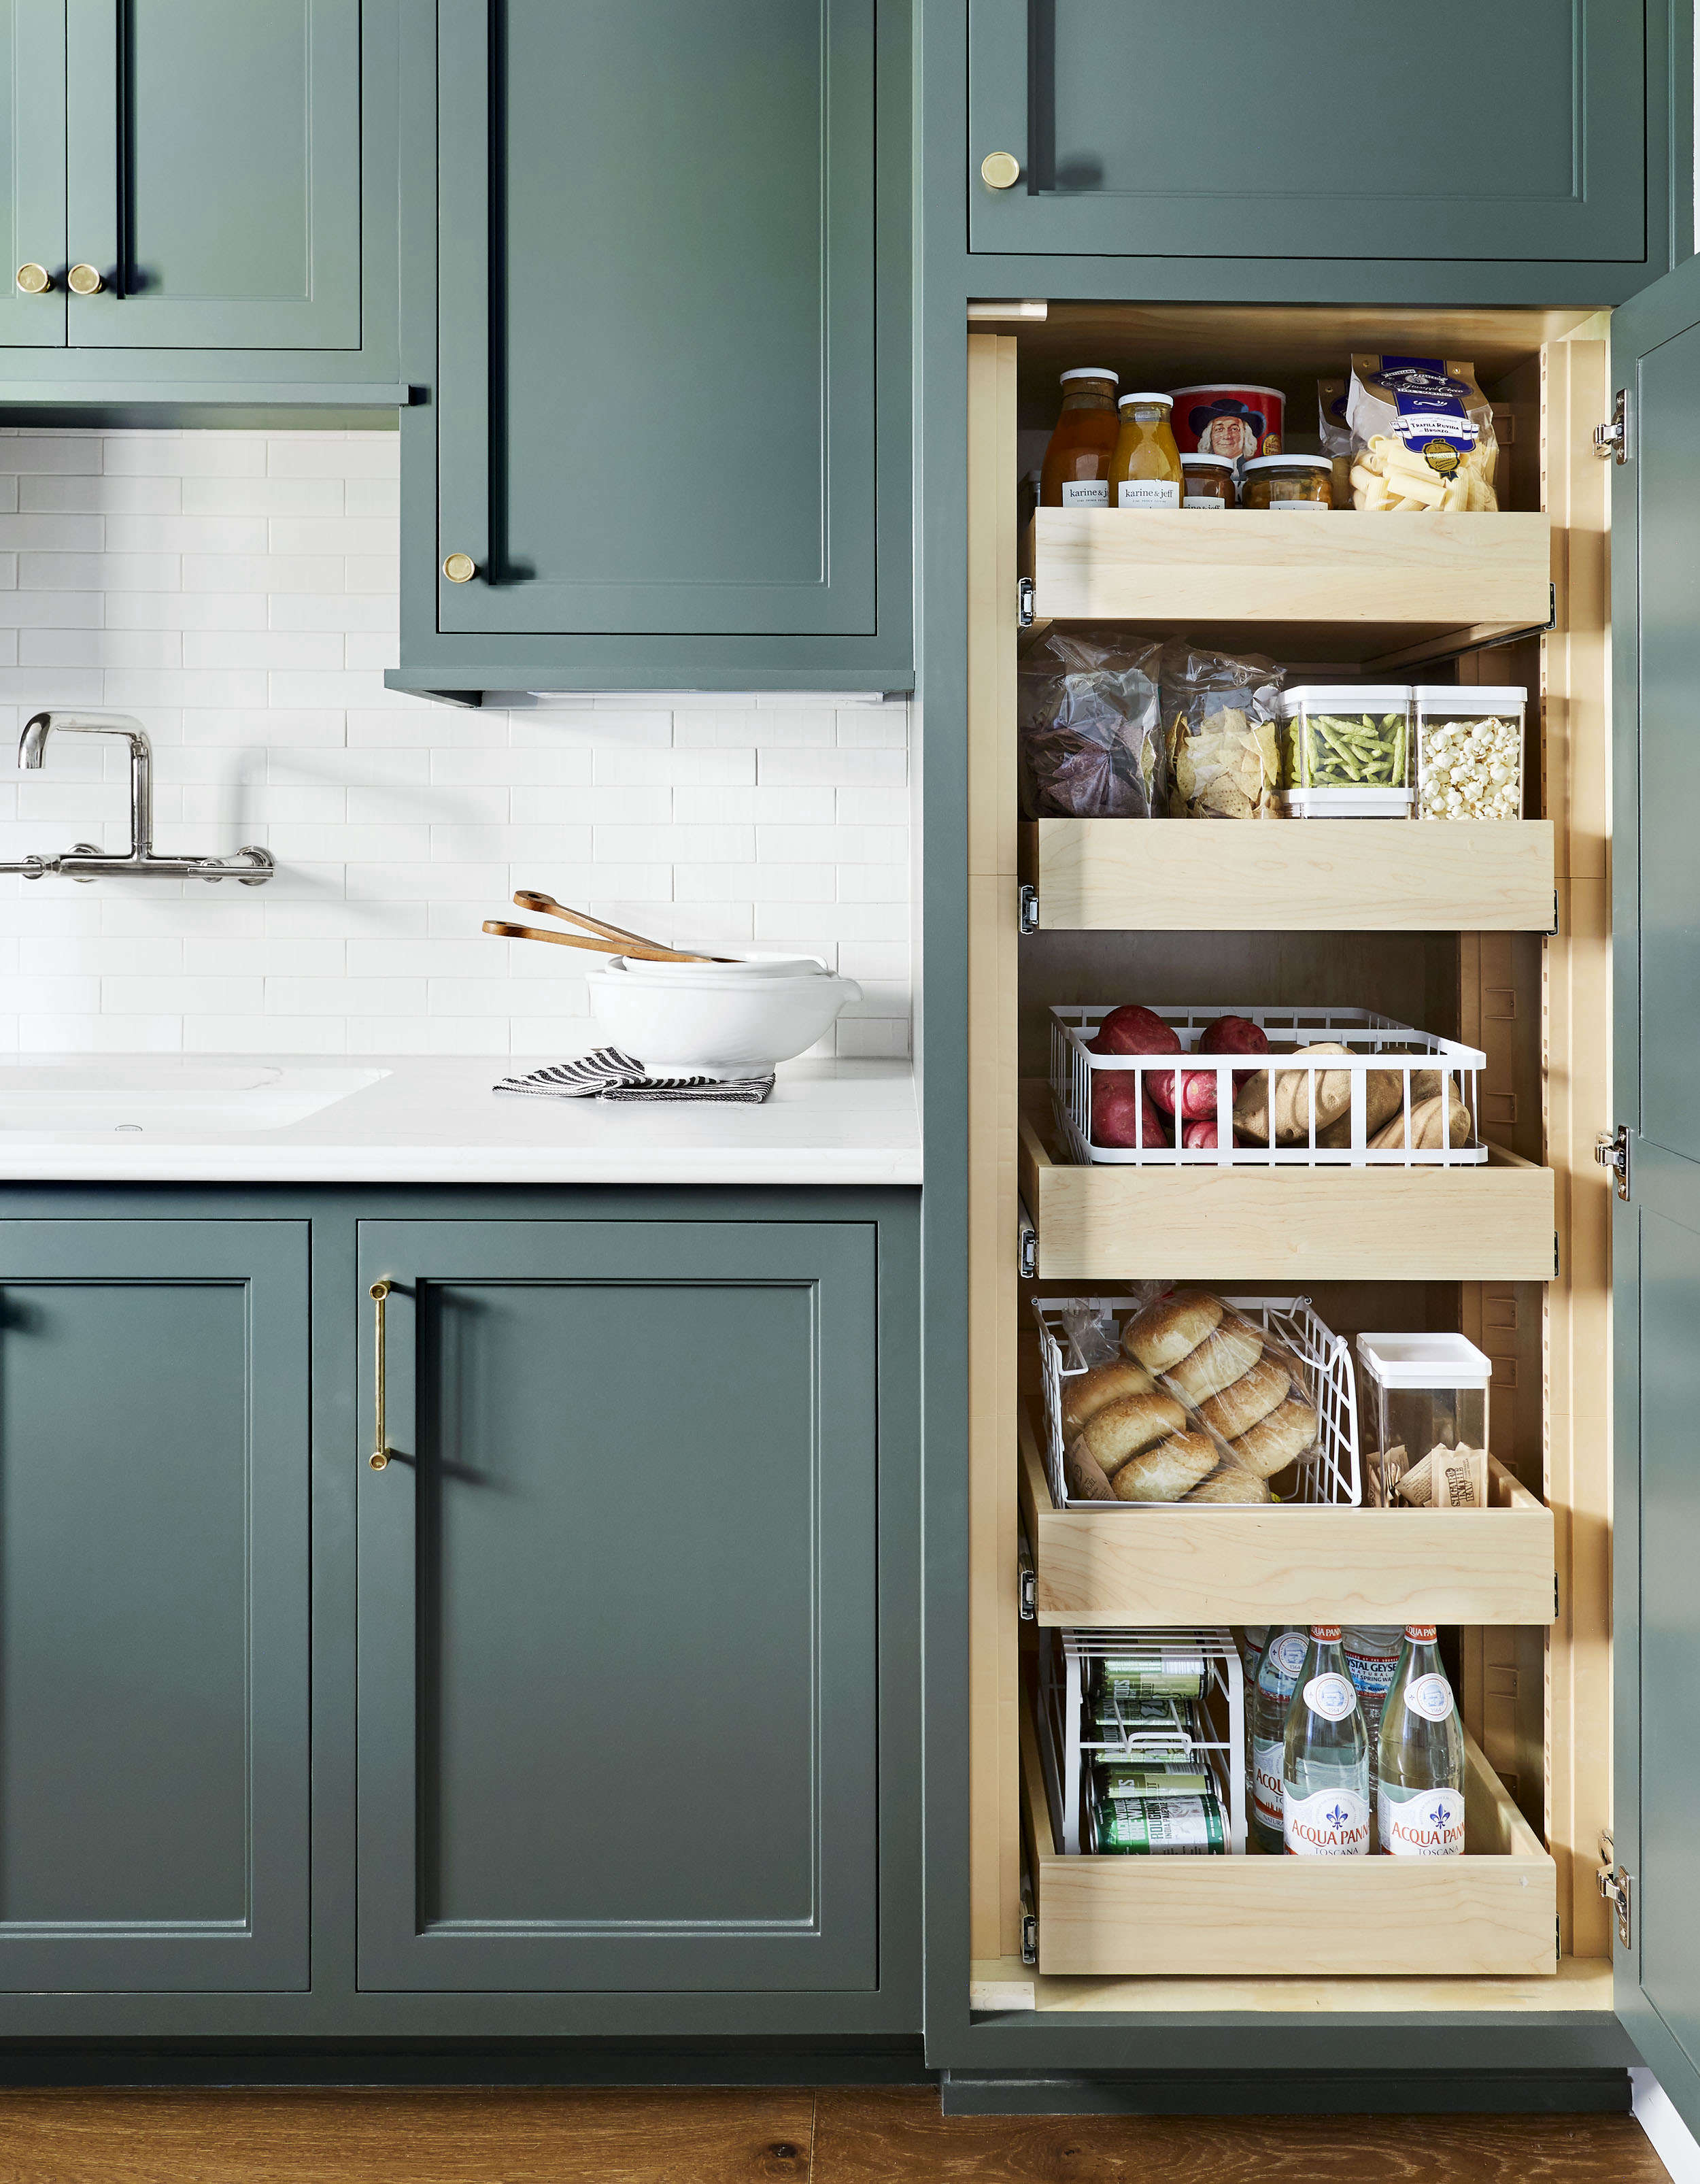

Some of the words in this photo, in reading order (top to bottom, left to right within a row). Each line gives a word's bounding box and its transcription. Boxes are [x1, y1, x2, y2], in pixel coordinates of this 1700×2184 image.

[1436, 422, 1459, 431] RUVIDA
[1070, 488, 1097, 497] karine
[1125, 488, 1153, 497] karine
[1160, 489, 1174, 499] jeff
[1455, 1467, 1465, 1488] THE
[1448, 1475, 1460, 1507] SUGAR
[1463, 1480, 1475, 1502] RAW
[1406, 1625, 1423, 1637] CQUA
[1347, 1658, 1369, 1671] YSTAL
[1370, 1663, 1397, 1672] GEYSE
[1351, 1668, 1389, 1677] NATURAL
[1257, 1768, 1283, 1796] ACQU
[1125, 1798, 1146, 1840] BREWING
[1161, 1808, 1171, 1822] PALE
[1163, 1824, 1172, 1839] INDIA
[1292, 1819, 1338, 1847] ACQUA
[1340, 1823, 1369, 1845] PANN
[1392, 1822, 1441, 1847] ACQUA
[1418, 1845, 1459, 1855] TOSCANA
